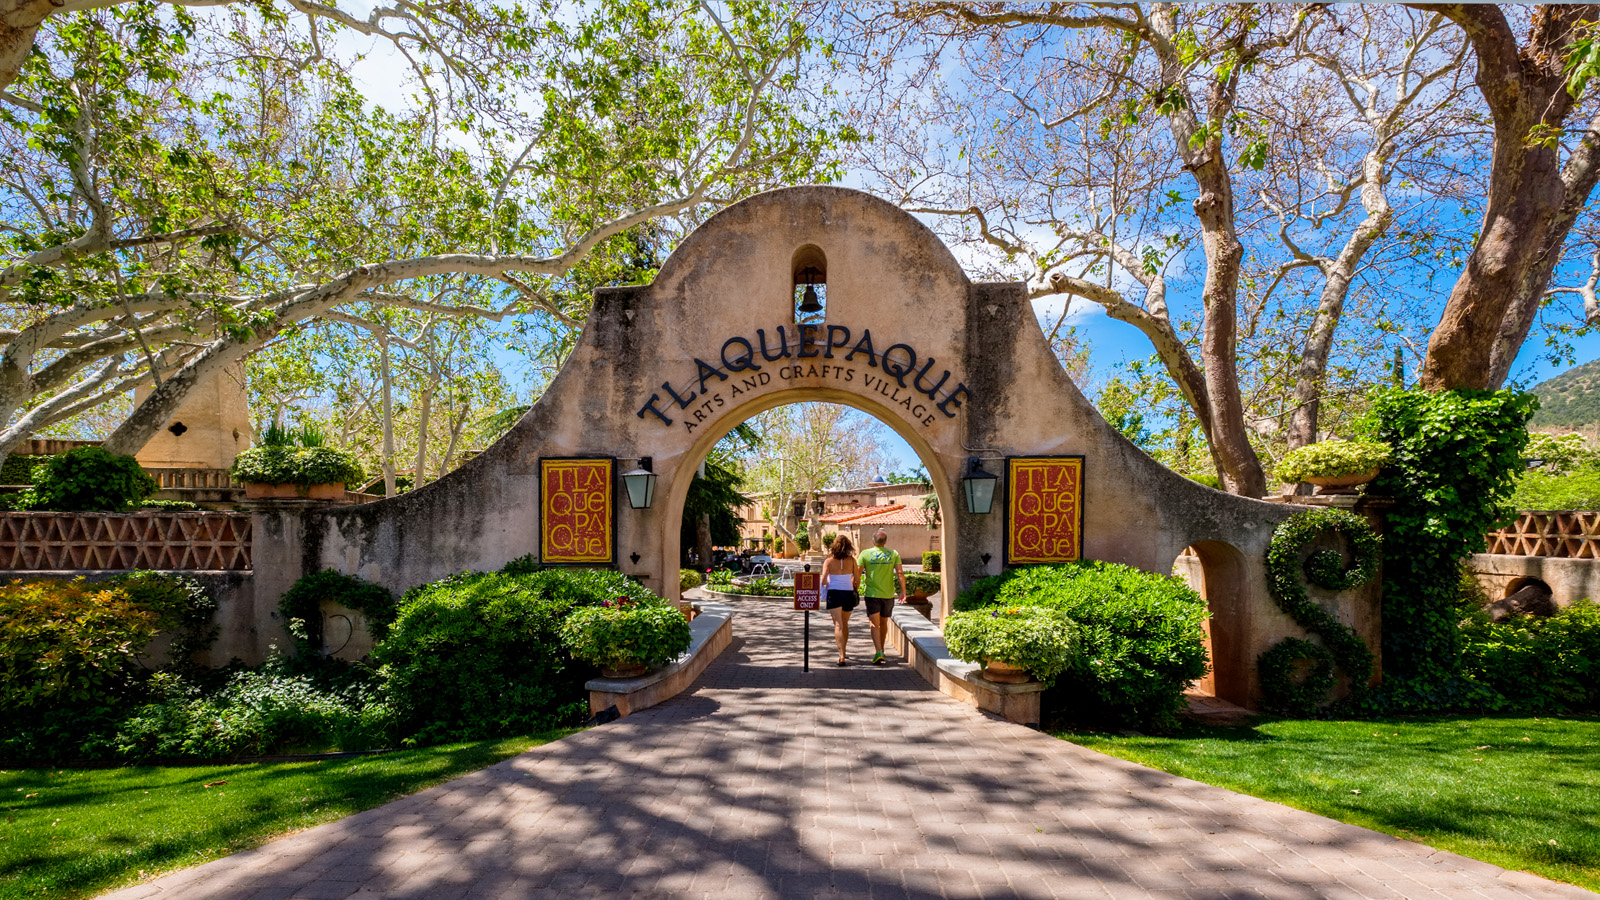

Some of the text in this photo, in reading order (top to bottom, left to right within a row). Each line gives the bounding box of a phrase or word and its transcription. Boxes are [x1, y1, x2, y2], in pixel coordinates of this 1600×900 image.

[637, 324, 970, 426] TLAQUEPAQUE
[683, 364, 935, 433] ARTS AND CRAFTS VILLAGE
